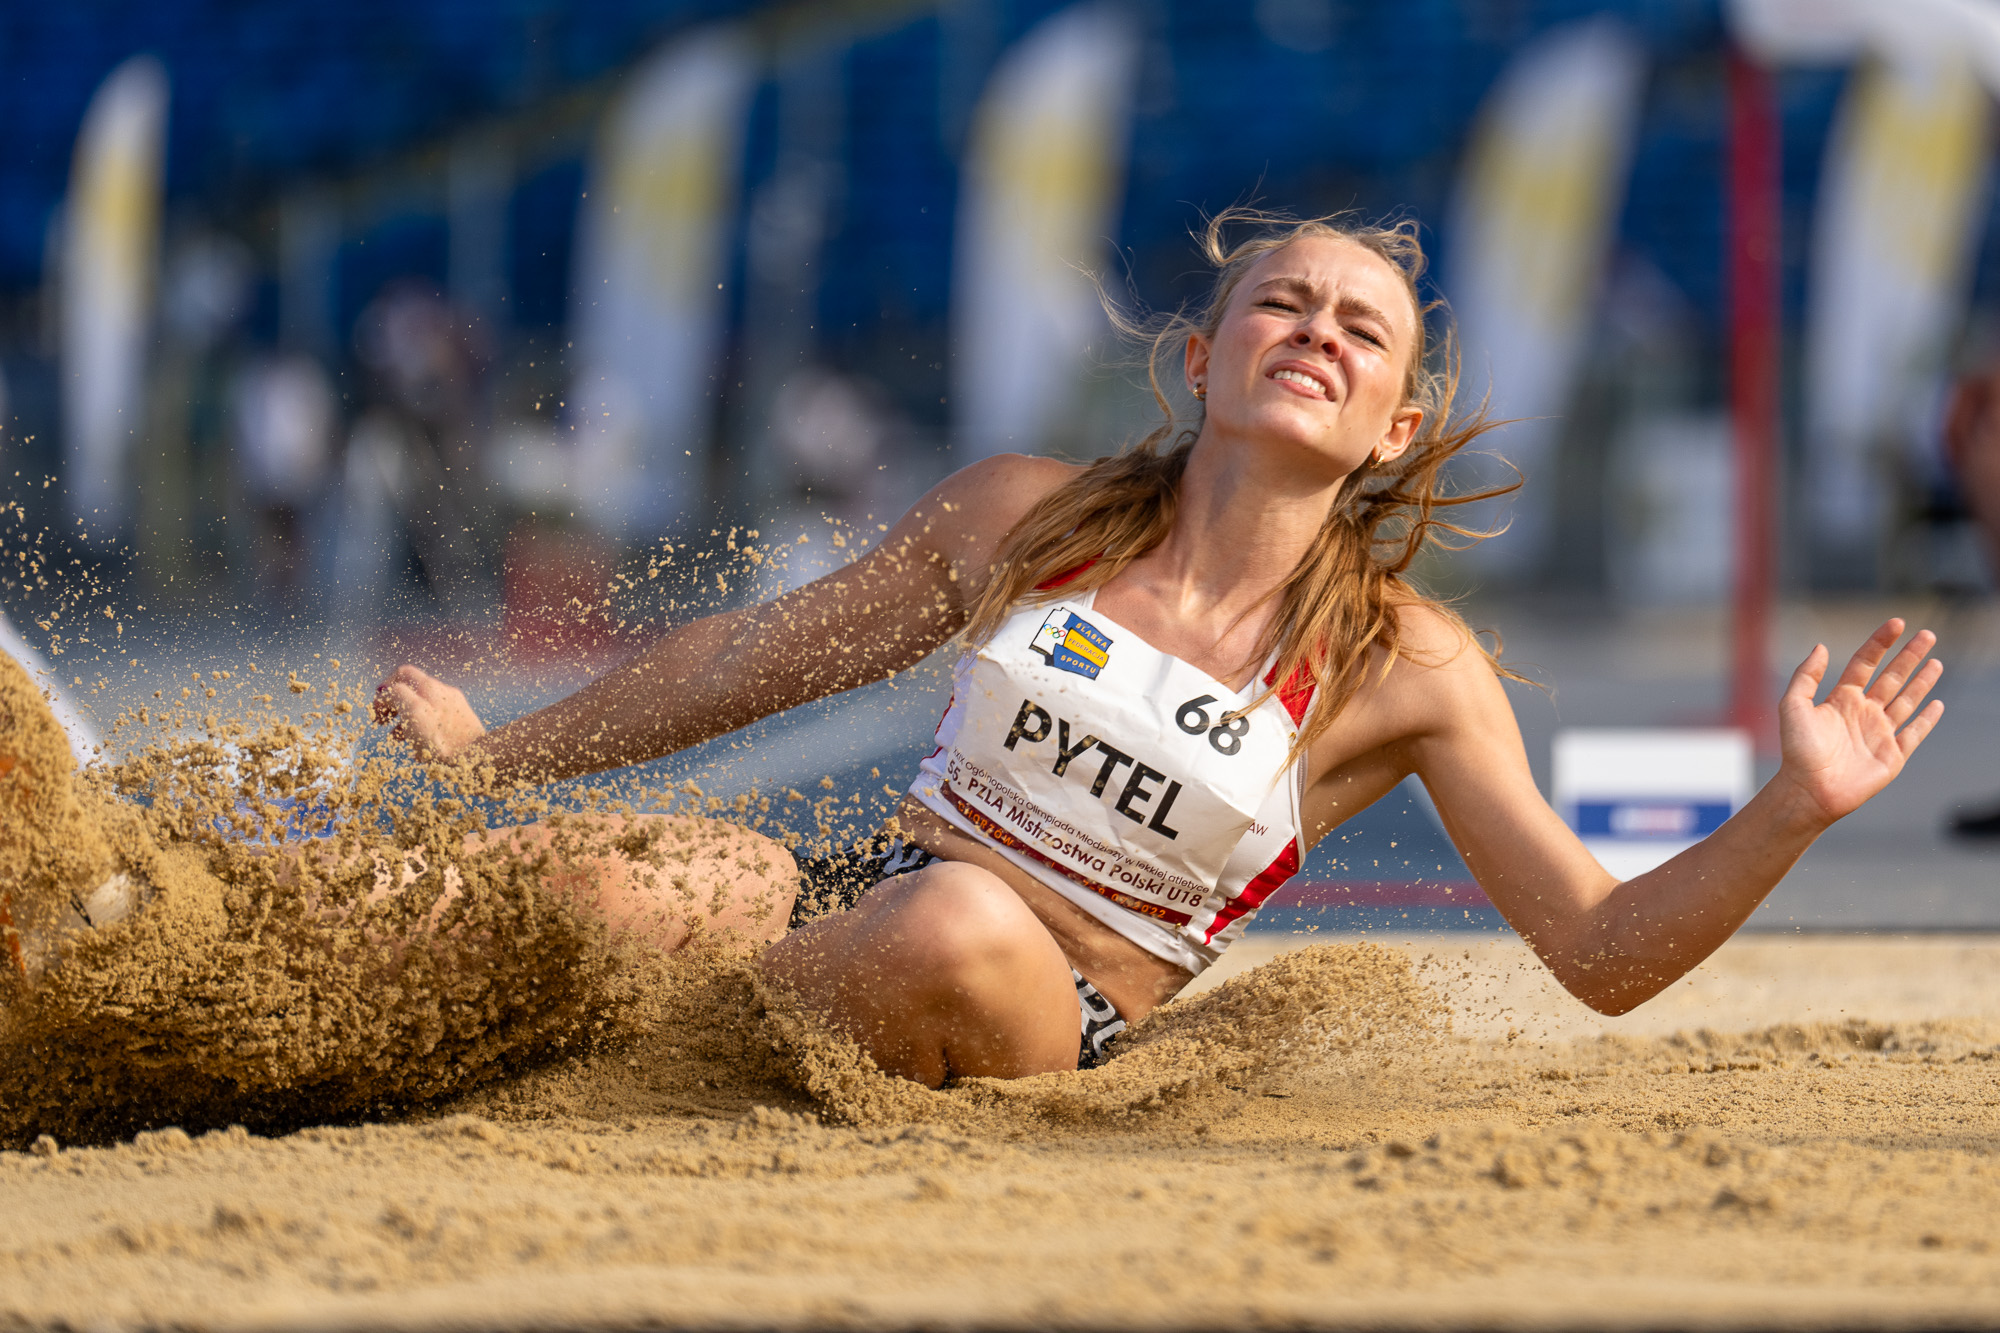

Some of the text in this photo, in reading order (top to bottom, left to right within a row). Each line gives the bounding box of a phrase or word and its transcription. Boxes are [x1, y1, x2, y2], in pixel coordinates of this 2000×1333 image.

[1060, 654, 1097, 674] SPORTU
[1067, 638, 1105, 661] FEDERACJA
[1003, 698, 1183, 841] PYTEL
[1175, 694, 1250, 756] 68
[947, 759, 1203, 908] 55. PZLA Mistrzostwa Polski U18
[965, 761, 1025, 806] Ogólnopolska
[1025, 801, 1076, 835] Olimpiada
[1124, 857, 1135, 866] w
[1135, 860, 1168, 881] lekkiej
[1168, 874, 1210, 894] atletyce
